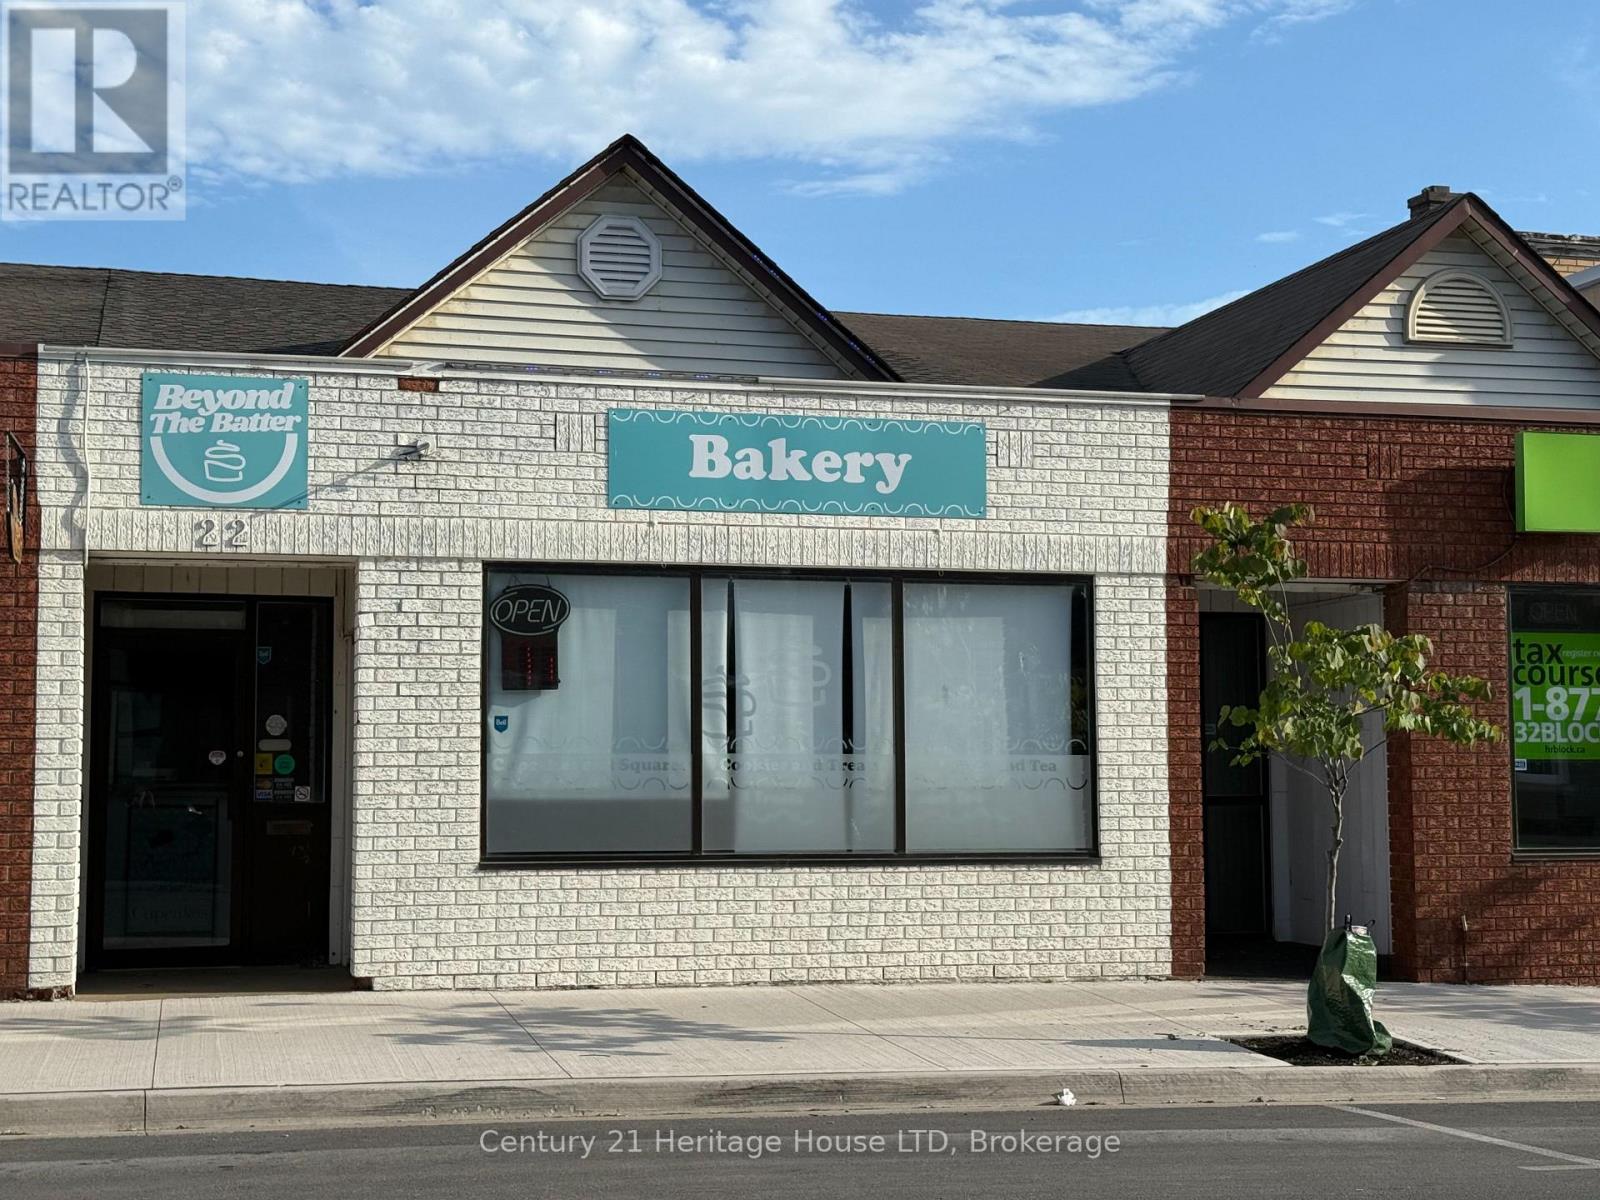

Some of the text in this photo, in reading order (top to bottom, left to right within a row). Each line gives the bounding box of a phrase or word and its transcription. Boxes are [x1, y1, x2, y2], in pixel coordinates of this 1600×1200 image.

[153, 381, 296, 416] Beyond
[150, 411, 302, 434] The Batter
[688, 433, 912, 494] Bakery
[199, 518, 250, 547] 22
[495, 599, 561, 623] OPEN
[1513, 638, 1563, 665] tax
[1544, 743, 1586, 754] hrblock.ca
[1029, 758, 1057, 772] Tea
